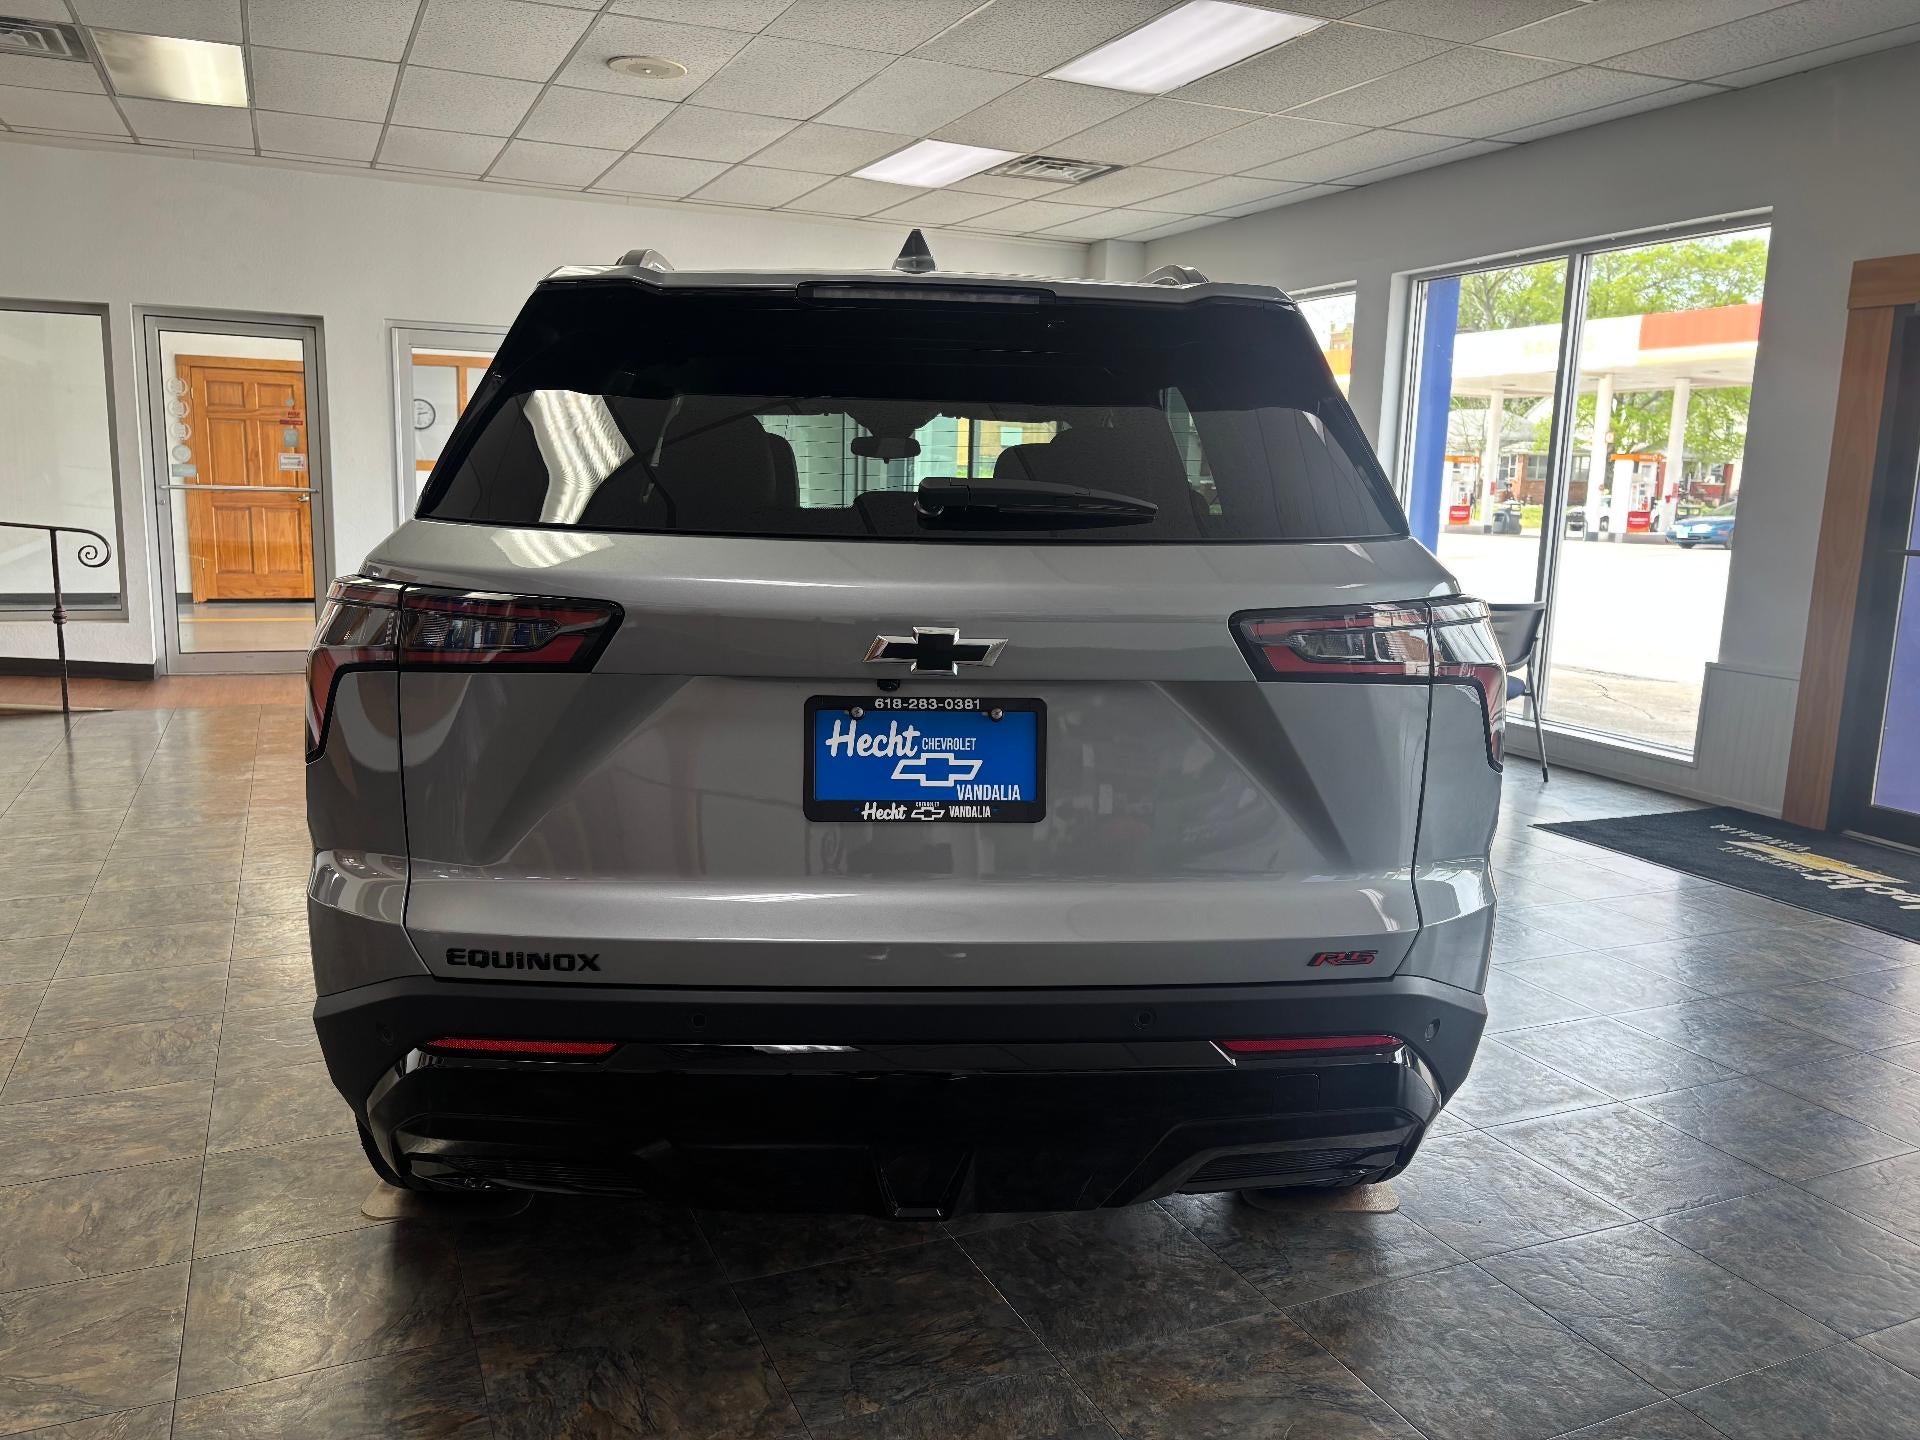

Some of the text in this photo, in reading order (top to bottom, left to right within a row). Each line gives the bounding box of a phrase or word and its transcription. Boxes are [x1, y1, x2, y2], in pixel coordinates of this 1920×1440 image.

[875, 698, 981, 710] 618-283-0381
[825, 719, 977, 758] Hecht CHEVROLET
[956, 784, 1021, 801] VANDALIA
[861, 801, 992, 820] Hecht VANDALIA
[445, 948, 602, 972] EQUINOX
[1306, 950, 1379, 967] RS
